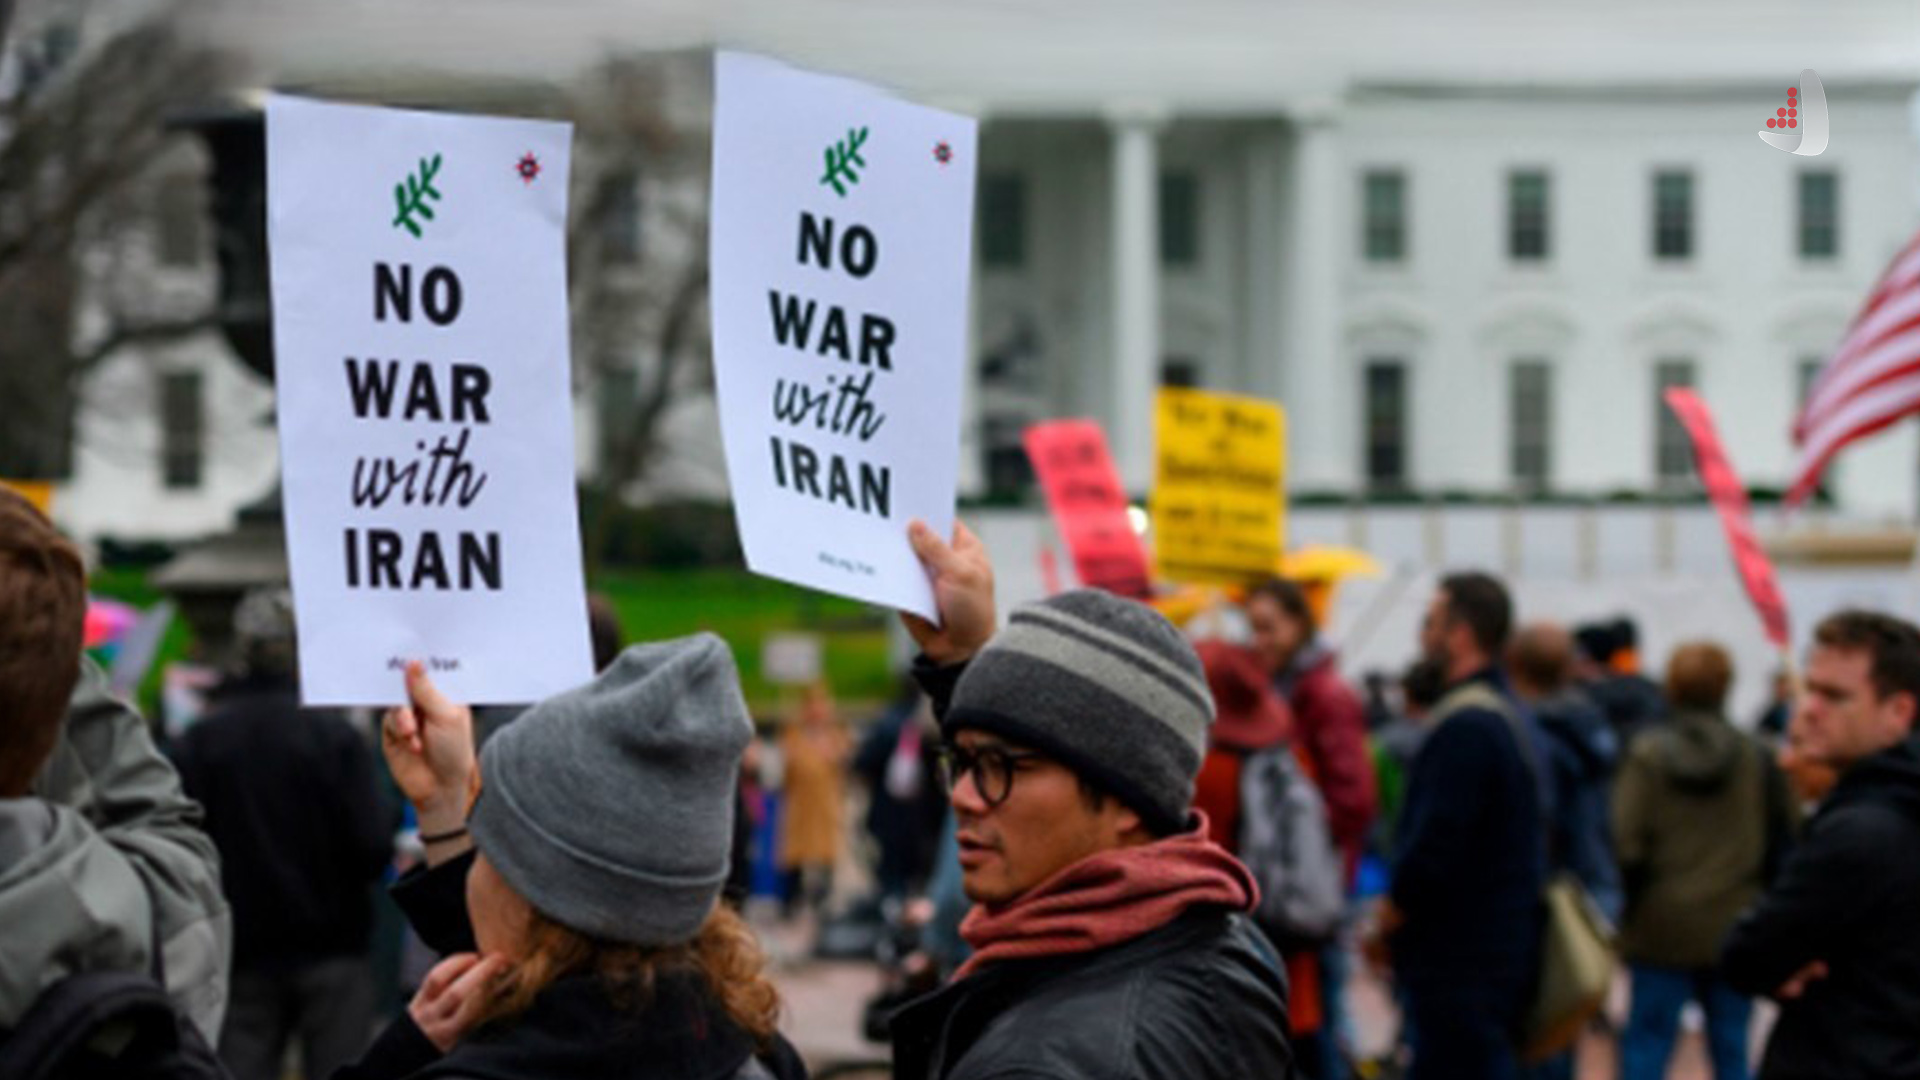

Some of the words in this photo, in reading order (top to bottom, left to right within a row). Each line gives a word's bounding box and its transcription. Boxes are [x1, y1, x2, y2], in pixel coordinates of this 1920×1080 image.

[796, 210, 879, 279] NO
[372, 261, 464, 327] NO
[768, 290, 896, 371] WAR
[343, 357, 492, 423] WAR
[772, 371, 885, 442] with
[351, 427, 487, 509] with
[769, 436, 892, 518] IRAN
[343, 527, 503, 591] IRAN
